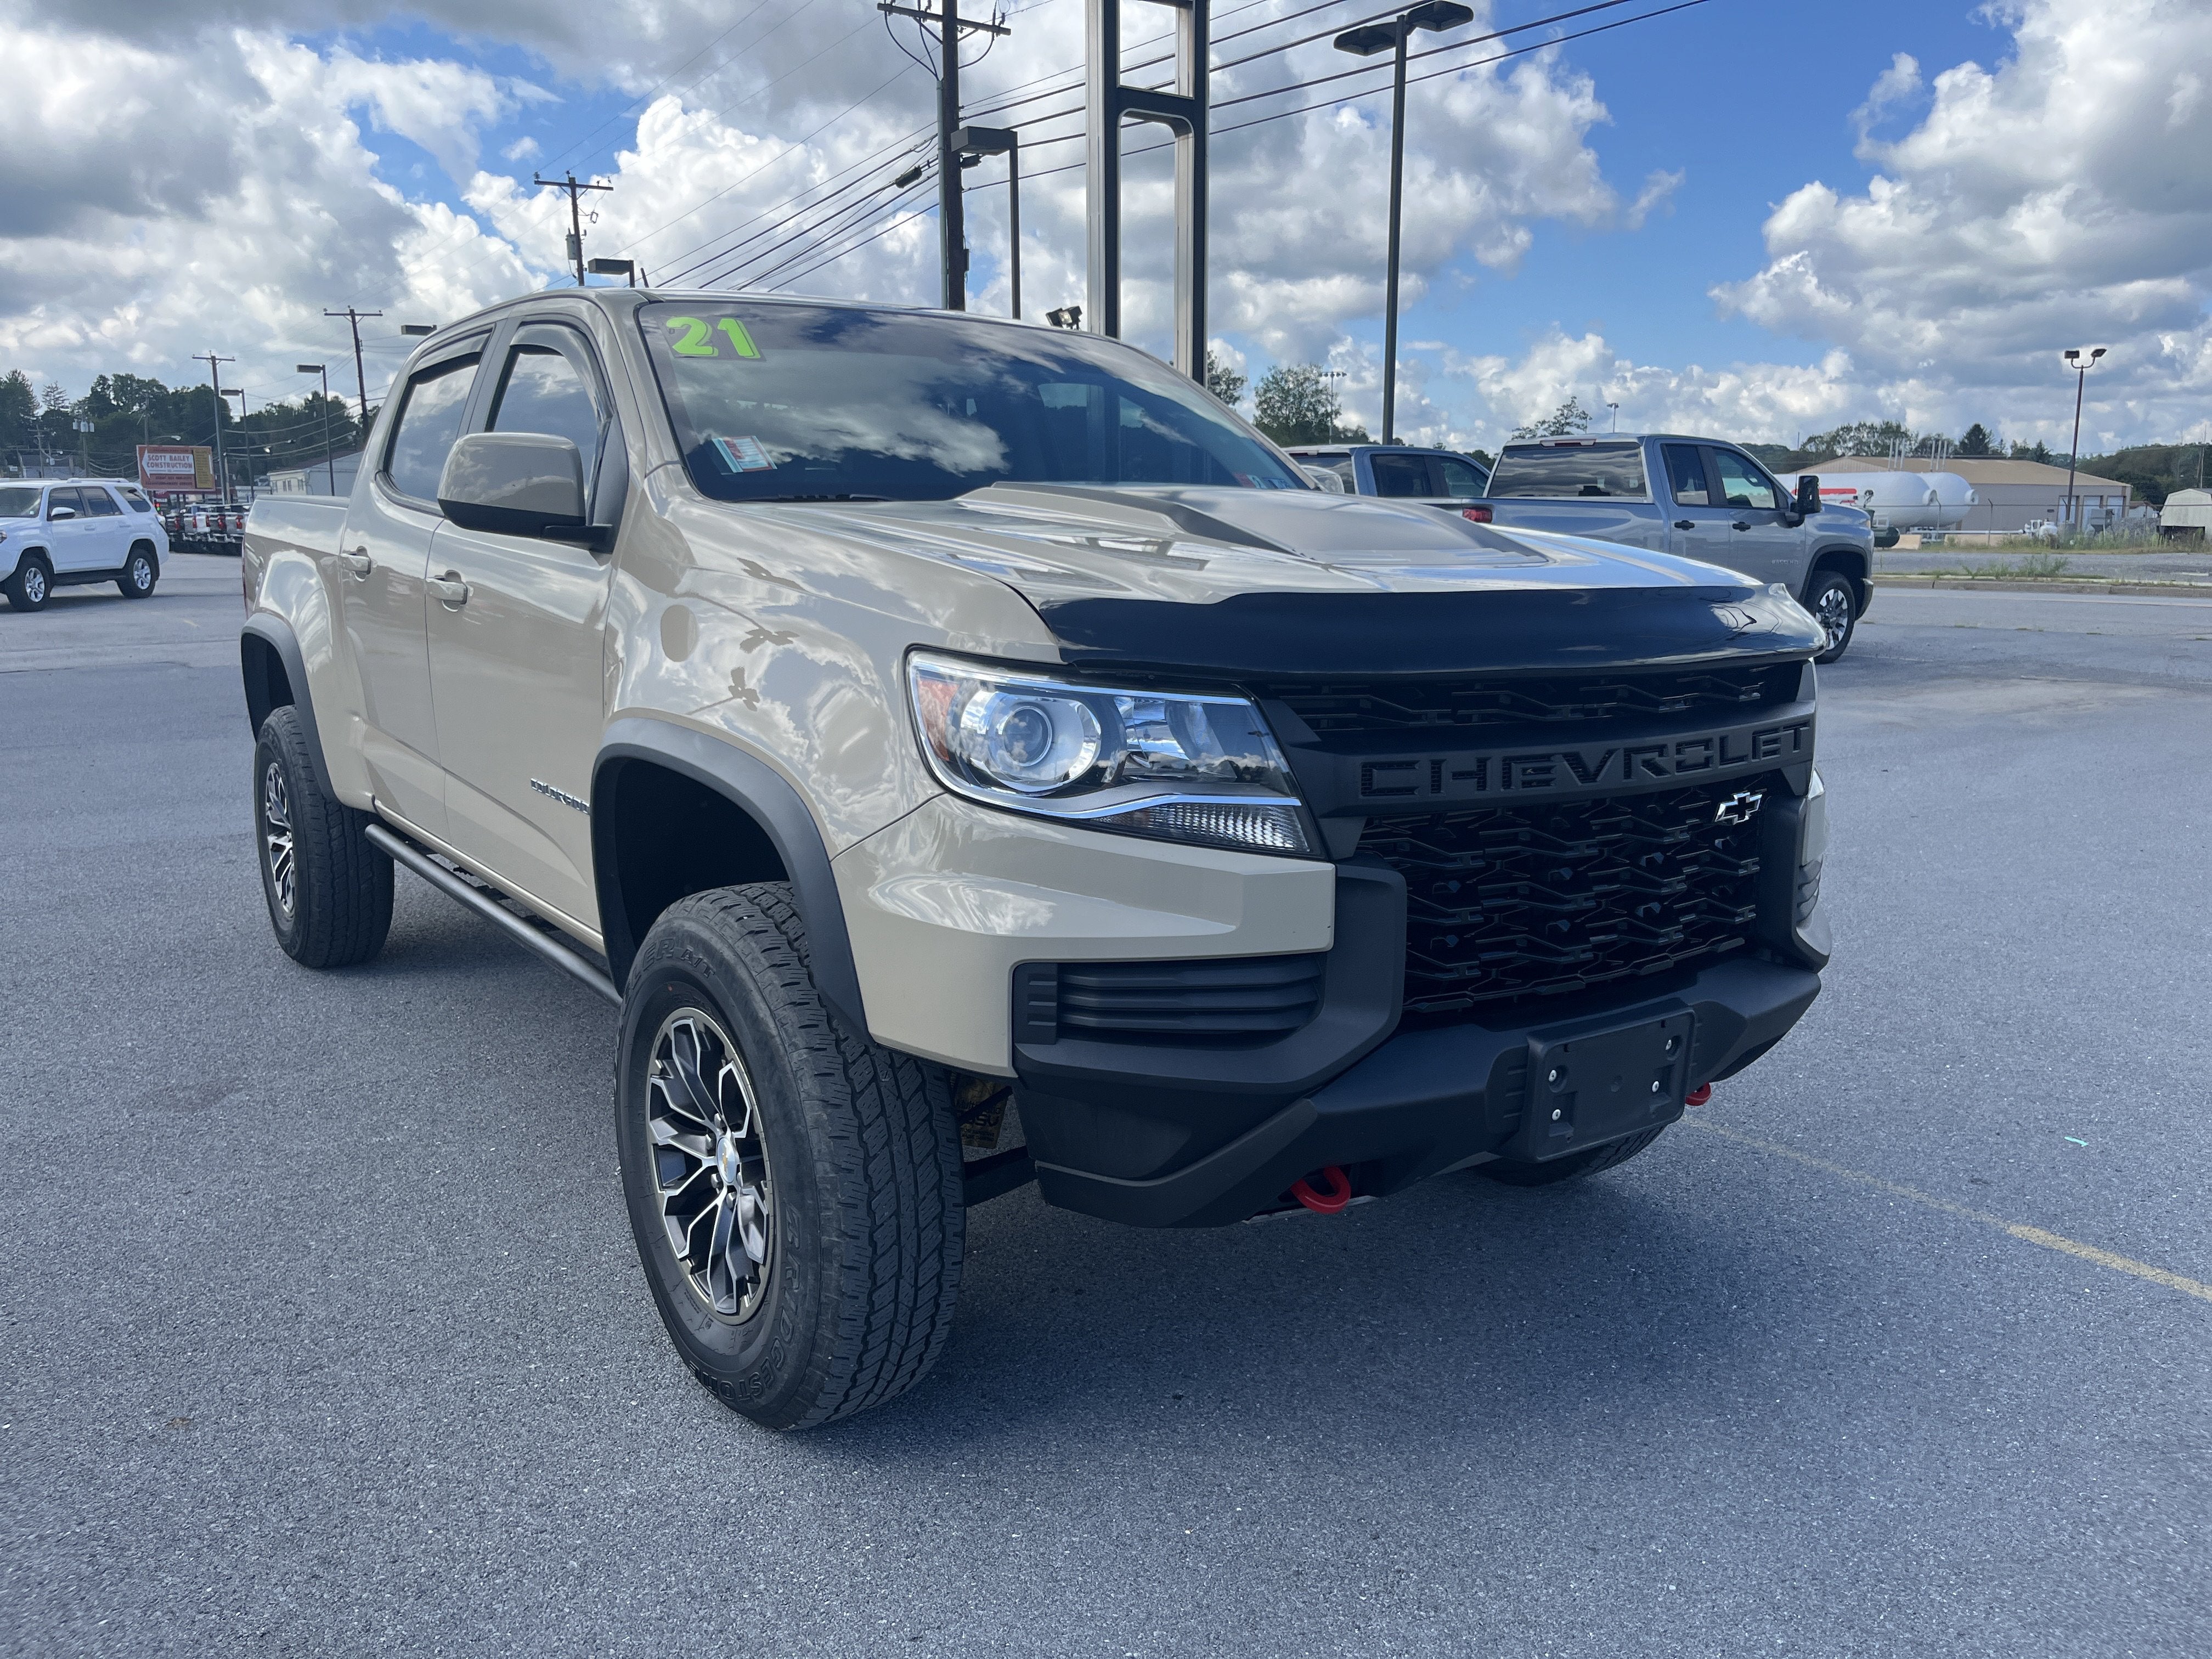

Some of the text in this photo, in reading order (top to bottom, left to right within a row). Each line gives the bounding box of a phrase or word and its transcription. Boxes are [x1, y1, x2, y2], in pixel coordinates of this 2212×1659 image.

[666, 317, 761, 359] 21
[1359, 720, 1812, 797] CHEVROLET
[689, 1200, 801, 1401] BRIDGESTONE
